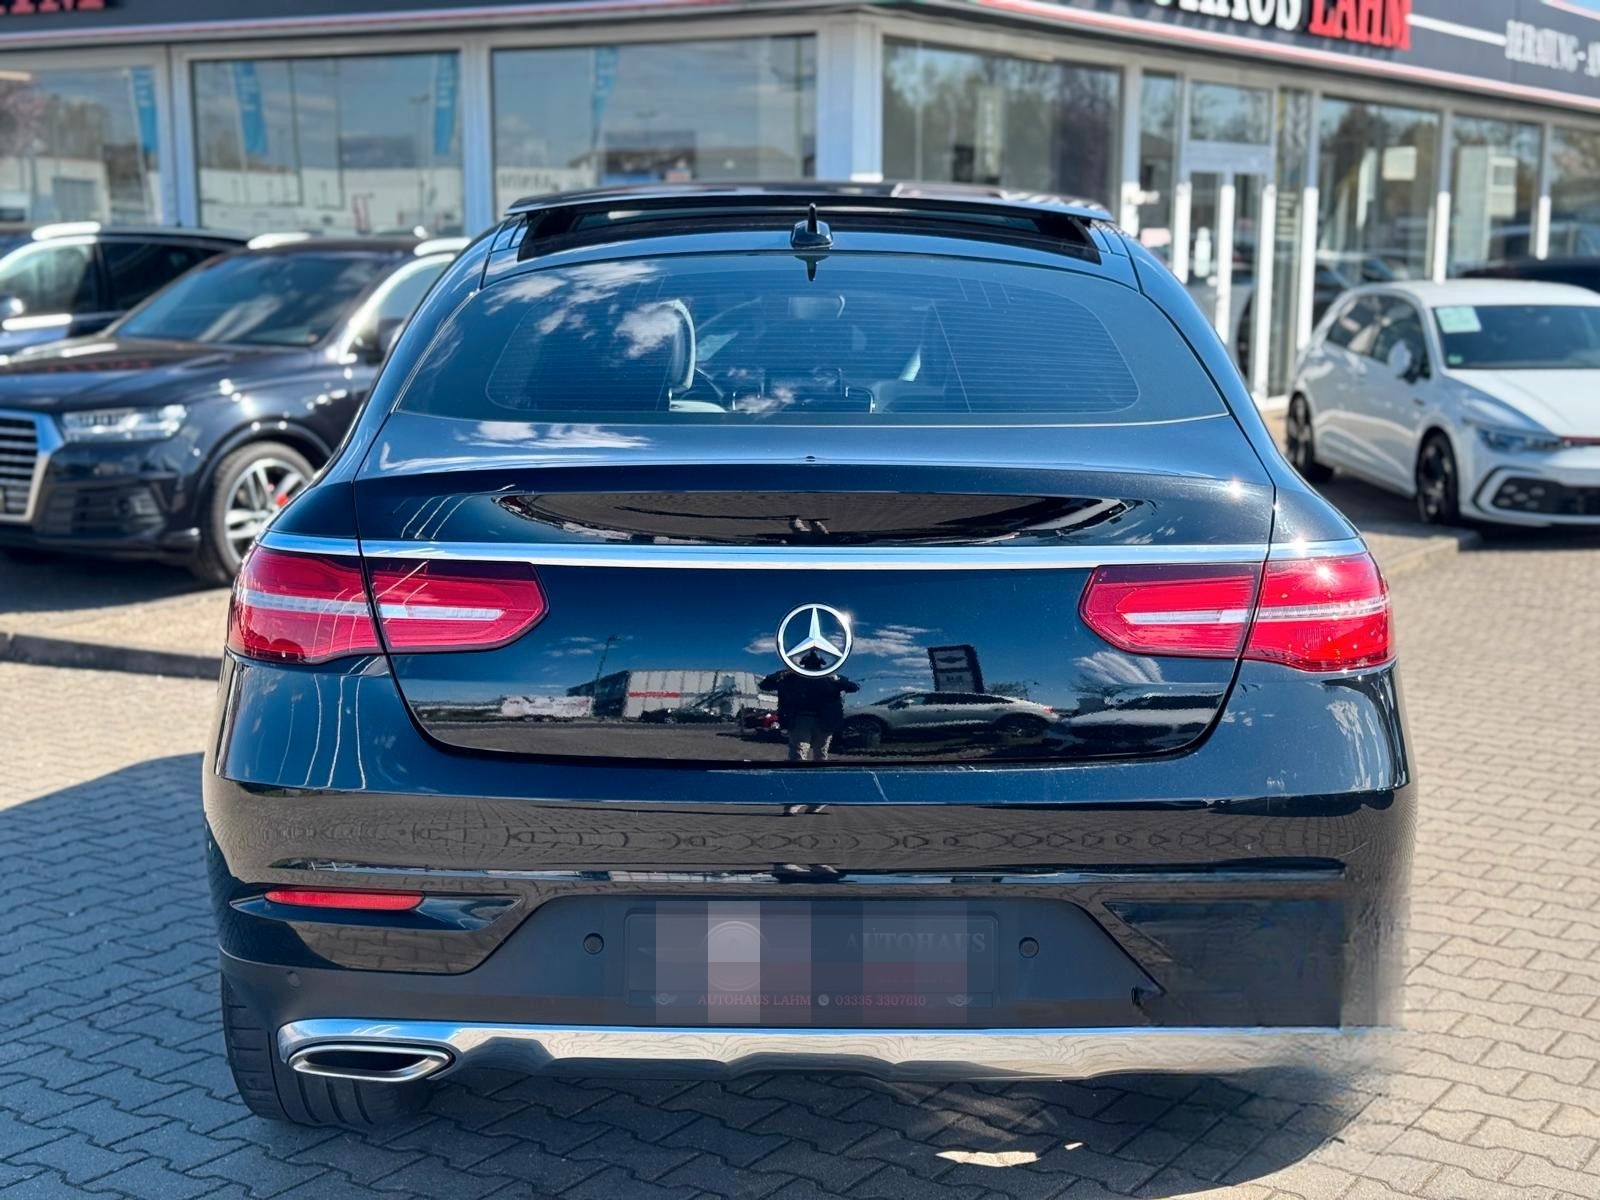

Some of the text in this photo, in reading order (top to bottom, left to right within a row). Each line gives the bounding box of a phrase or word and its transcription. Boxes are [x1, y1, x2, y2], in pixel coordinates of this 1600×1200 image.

[844, 932, 986, 953] AUTOHAUS
[698, 994, 769, 1006] AUTOHAUS
[773, 994, 811, 1006] LAHM
[835, 995, 872, 1006] 03335
